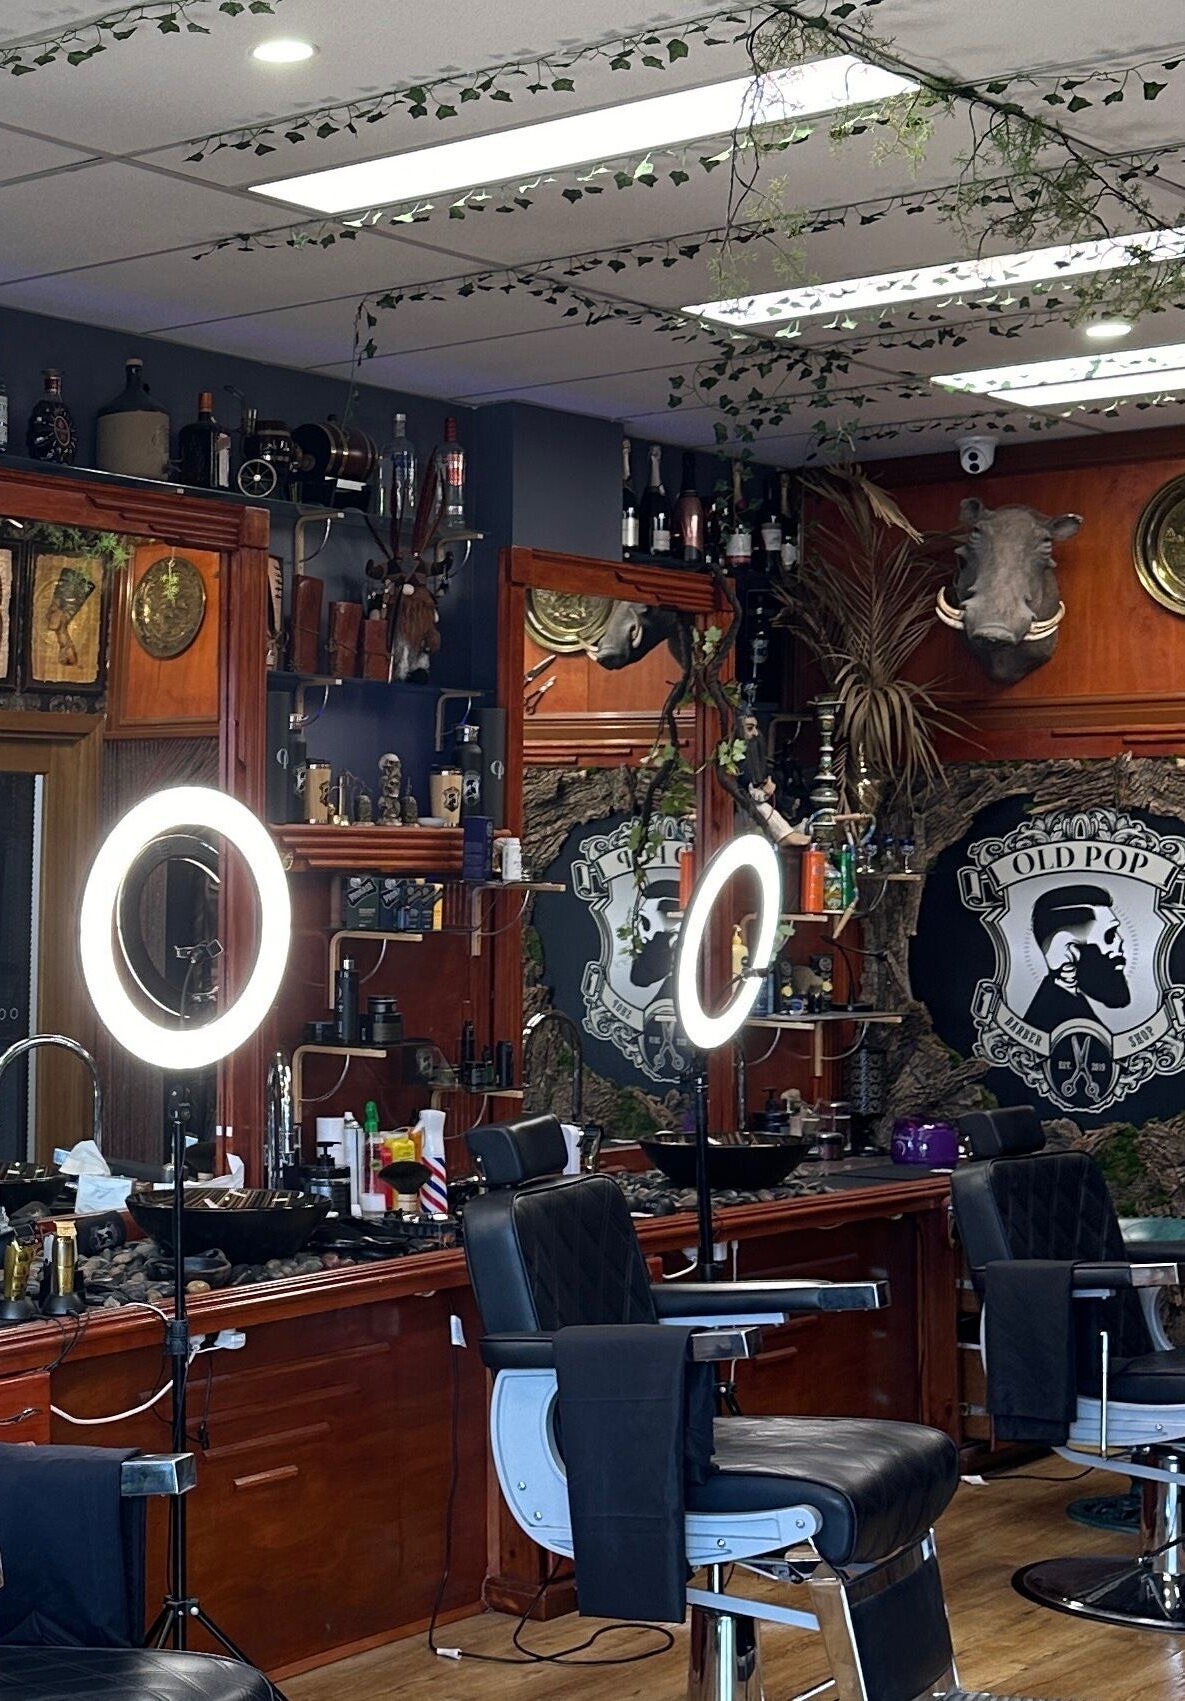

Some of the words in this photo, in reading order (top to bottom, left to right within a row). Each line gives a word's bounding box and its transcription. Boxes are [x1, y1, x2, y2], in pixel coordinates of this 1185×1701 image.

[1012, 846, 1075, 875] OLD
[1085, 846, 1149, 874] POP
[1004, 1013, 1043, 1047] BARBER
[1128, 1025, 1155, 1048] SHOP
